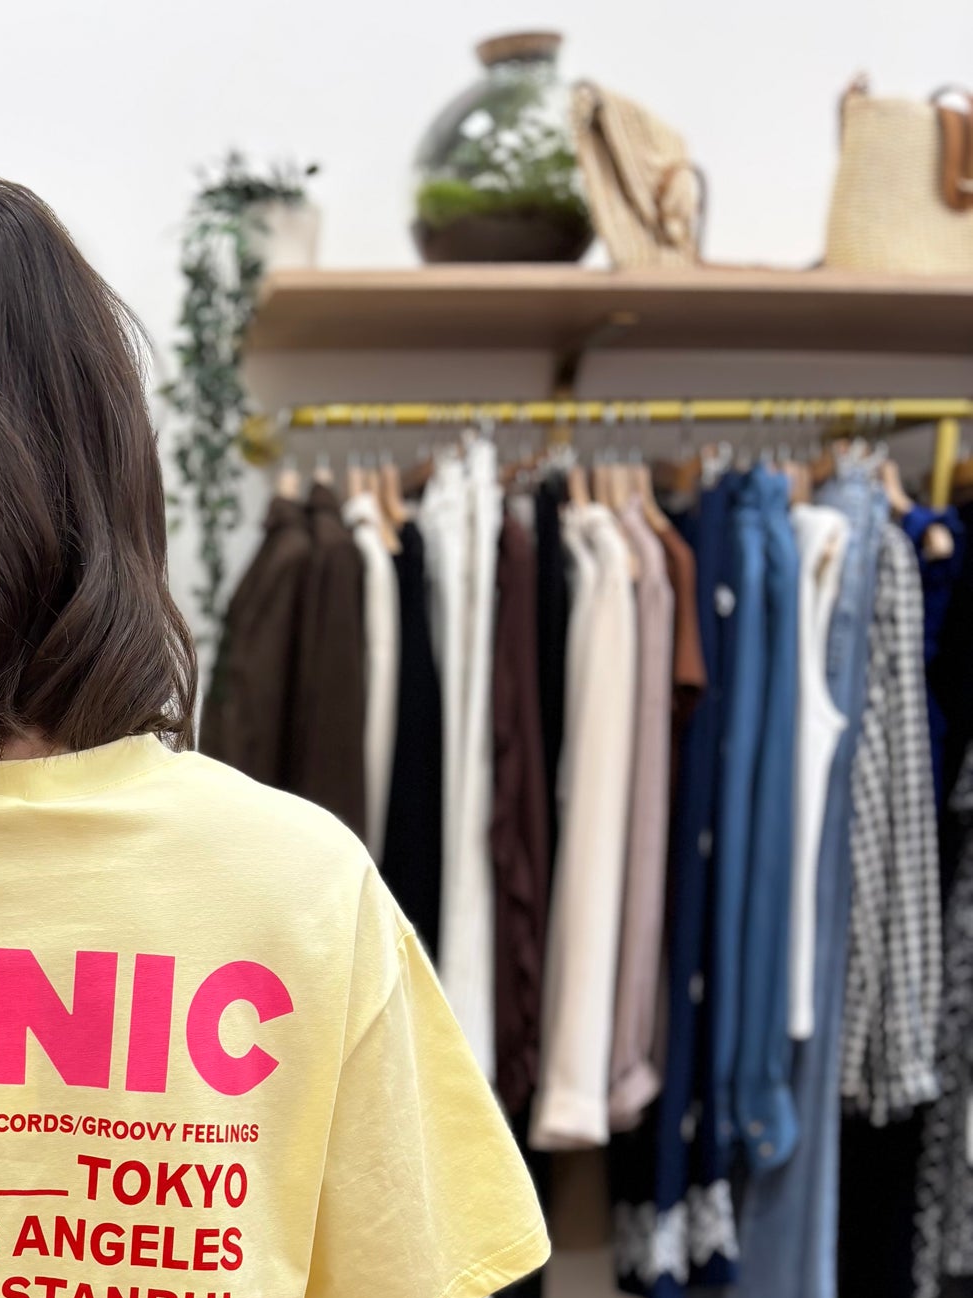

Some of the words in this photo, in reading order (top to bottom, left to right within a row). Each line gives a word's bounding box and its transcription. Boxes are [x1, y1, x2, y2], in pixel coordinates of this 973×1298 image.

[181, 1122, 259, 1144] FEELINGS
[76, 1153, 248, 1209] TOKYO
[11, 1215, 244, 1272] ANGELES
